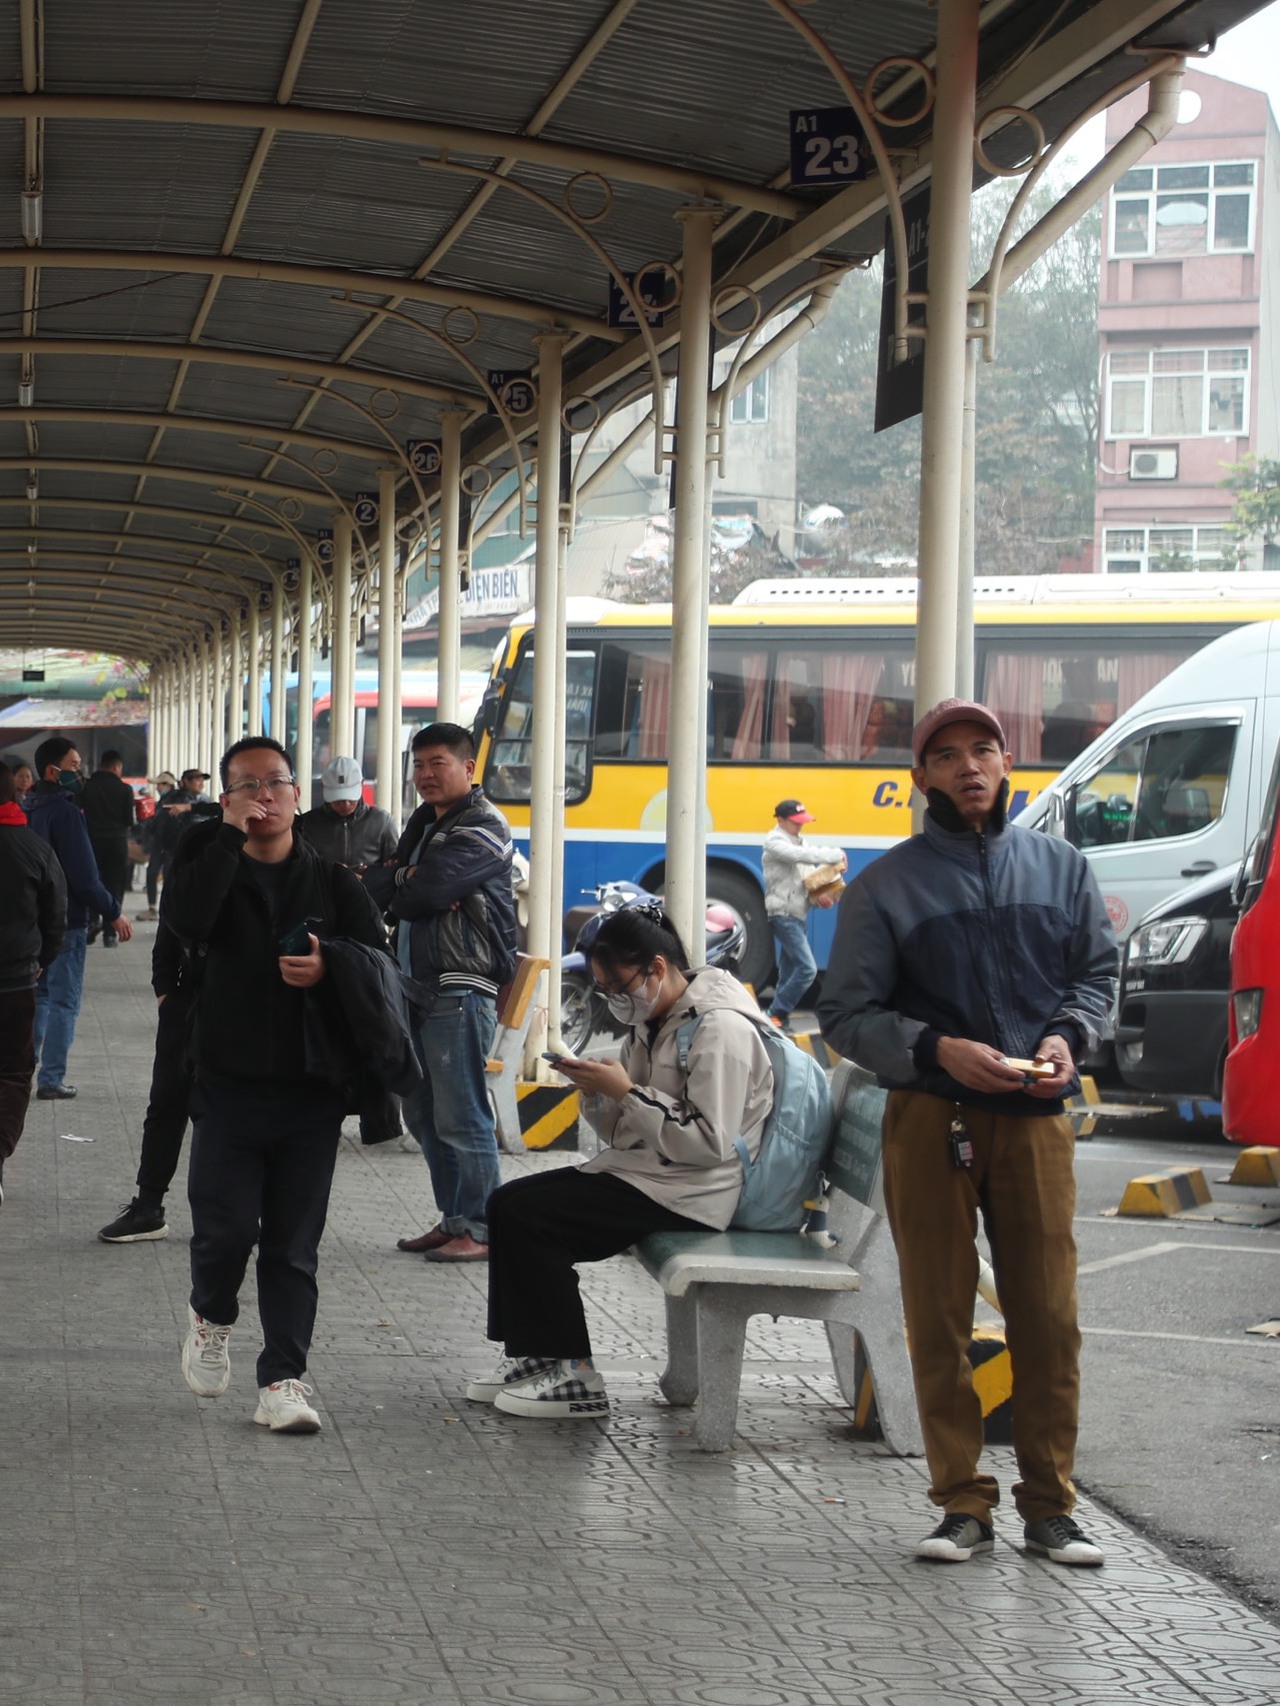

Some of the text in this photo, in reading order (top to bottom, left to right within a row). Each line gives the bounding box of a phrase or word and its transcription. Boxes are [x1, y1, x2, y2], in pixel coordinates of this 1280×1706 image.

[796, 115, 818, 133] A1
[804, 136, 860, 177] 23
[491, 373, 505, 385] A1
[492, 568, 519, 598] BIÊN
